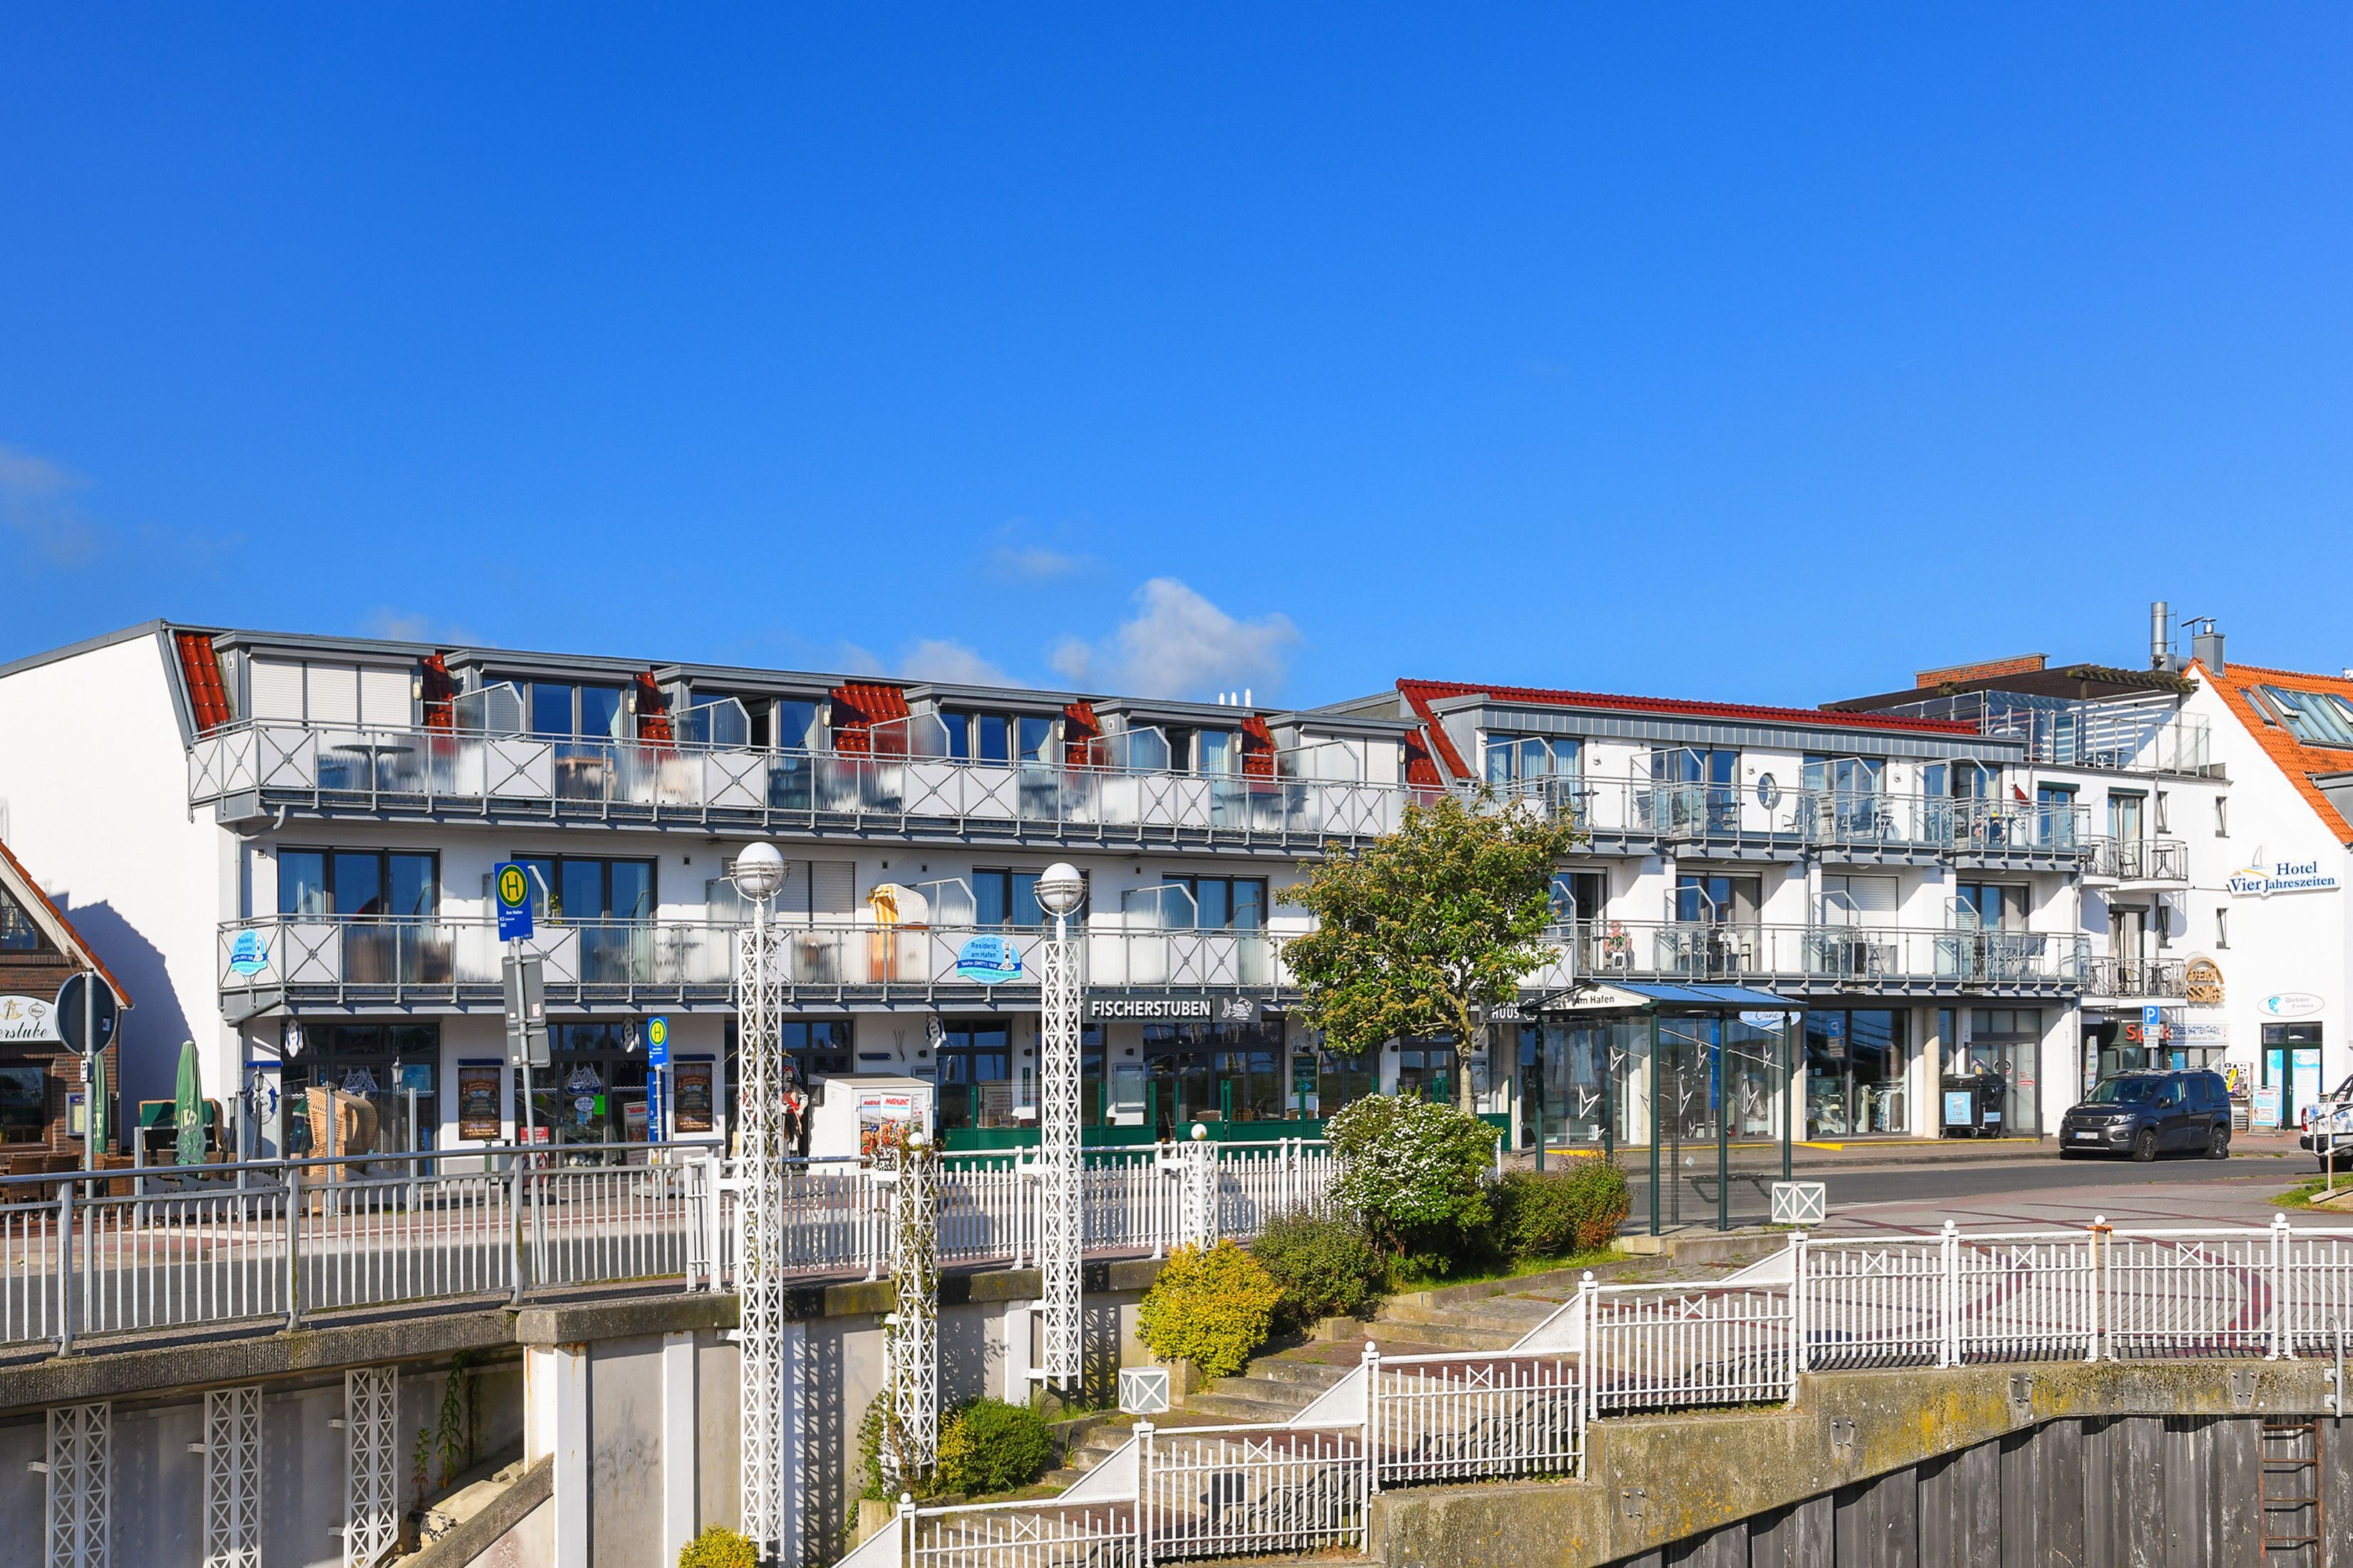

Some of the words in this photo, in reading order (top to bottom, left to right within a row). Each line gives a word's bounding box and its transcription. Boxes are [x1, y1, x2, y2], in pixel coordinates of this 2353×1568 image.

[2276, 861, 2317, 876] Hotel
[2230, 878, 2261, 891] Vier
[2263, 876, 2335, 893] Jahreszeiten
[1574, 997, 1588, 1005] Am
[1590, 996, 1615, 1004] Hafen
[1092, 1000, 1210, 1017] FISCHERSTUBEN
[1491, 1008, 1519, 1019] HUUS
[2146, 1007, 2156, 1023] P
